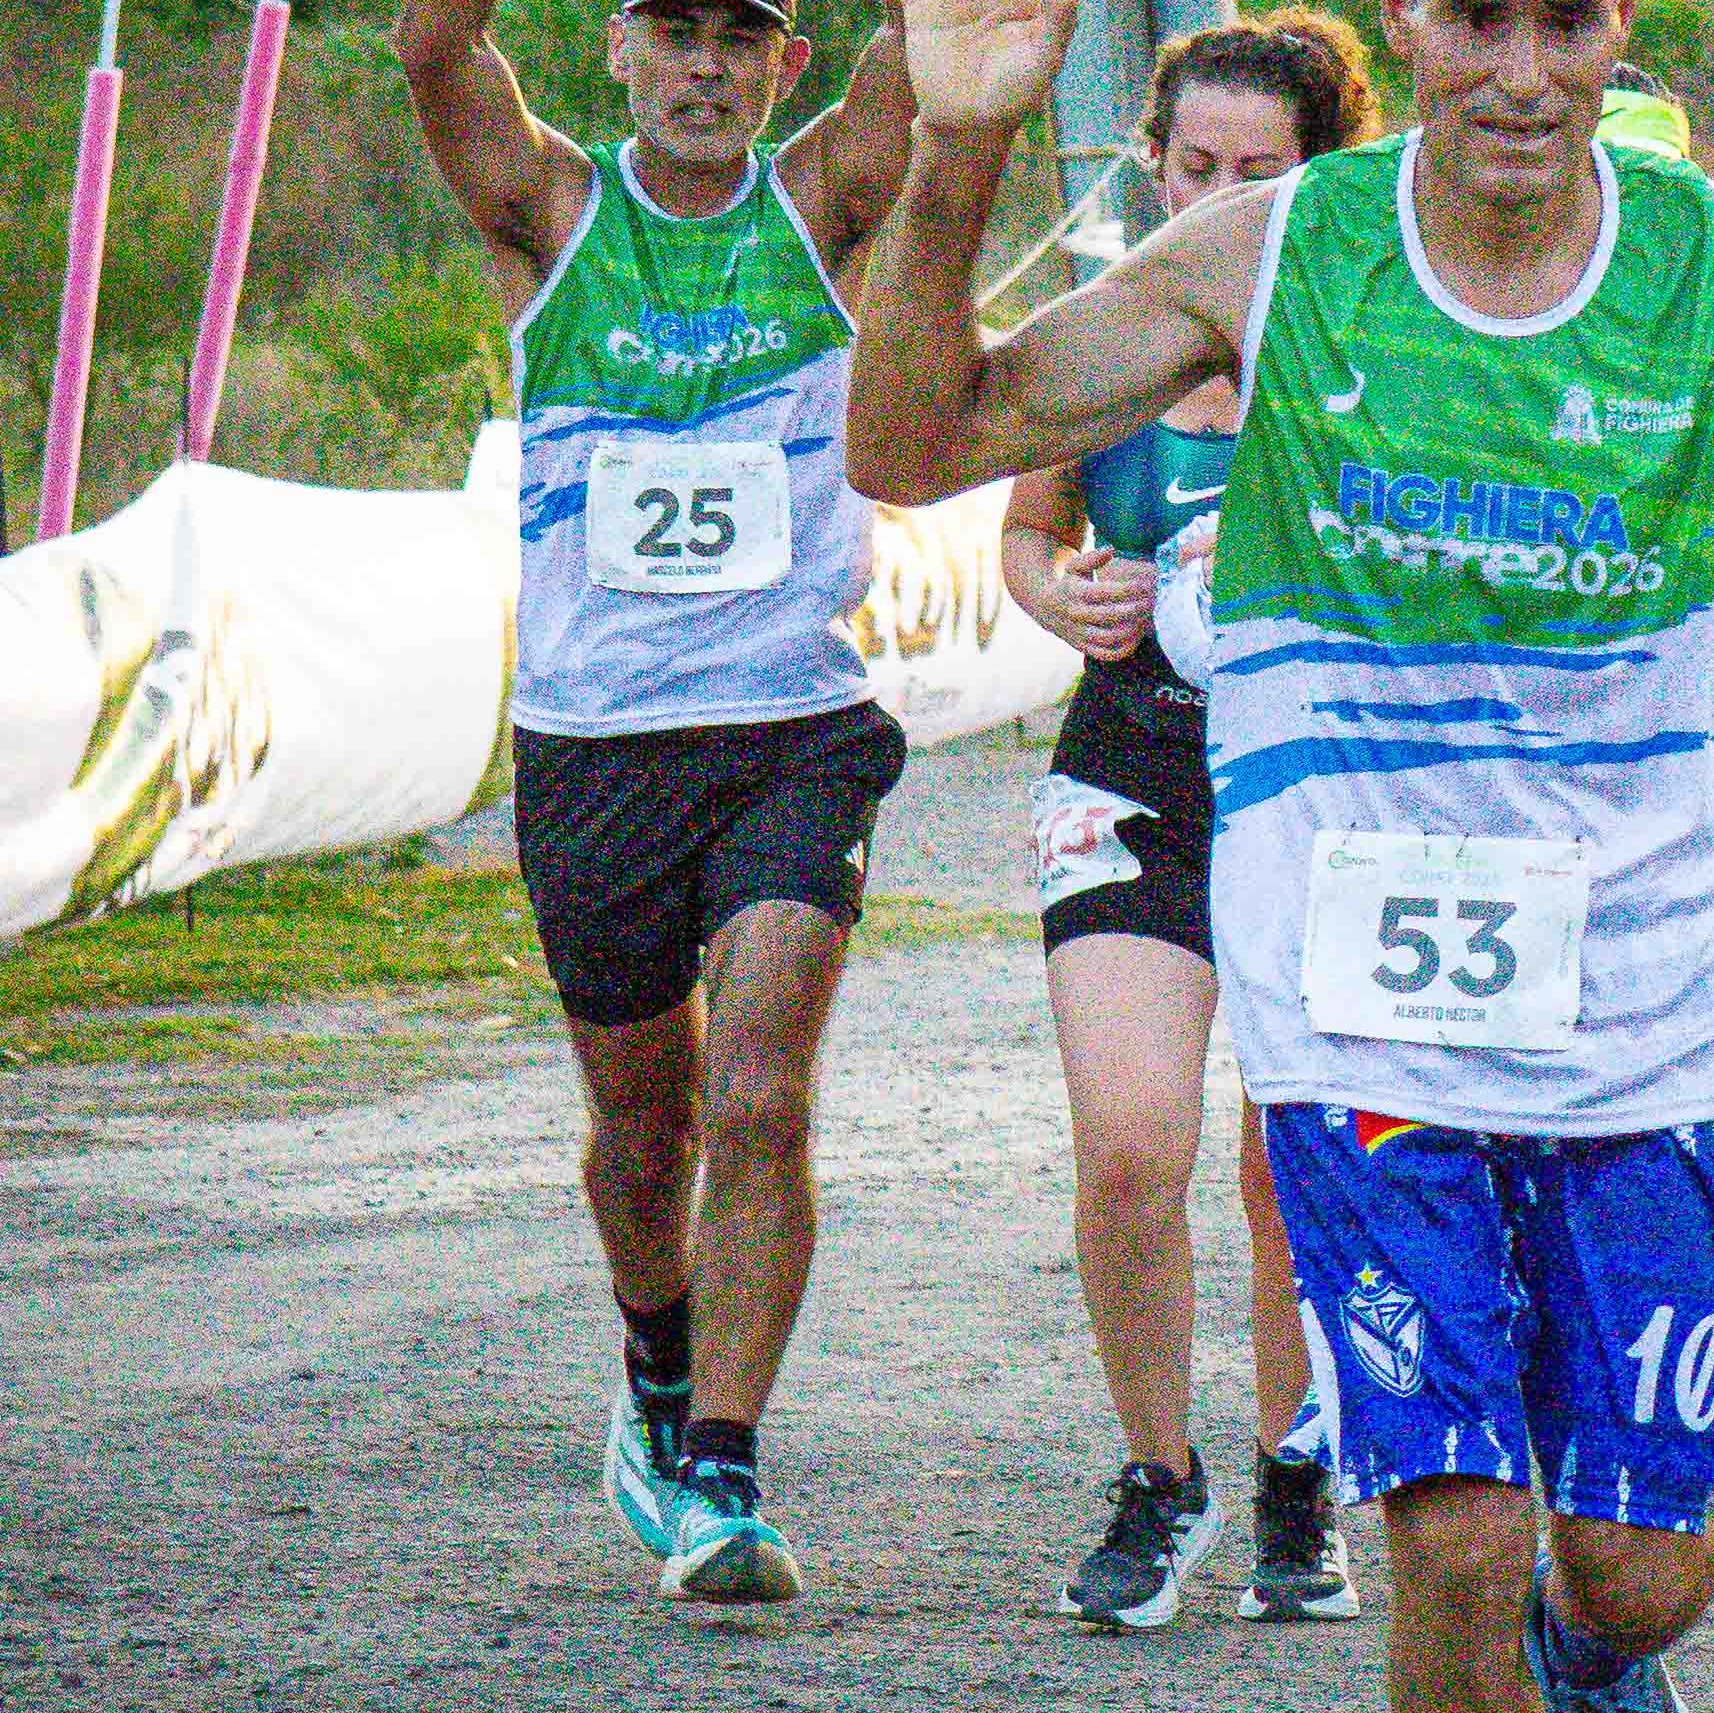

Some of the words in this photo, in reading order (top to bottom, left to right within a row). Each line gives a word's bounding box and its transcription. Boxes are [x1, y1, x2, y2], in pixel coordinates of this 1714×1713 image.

[633, 487, 736, 558] 25
[1338, 460, 1630, 553] FIGHIERA
[1370, 895, 1518, 999] 53
[1392, 1004, 1443, 1022] ALBERTO
